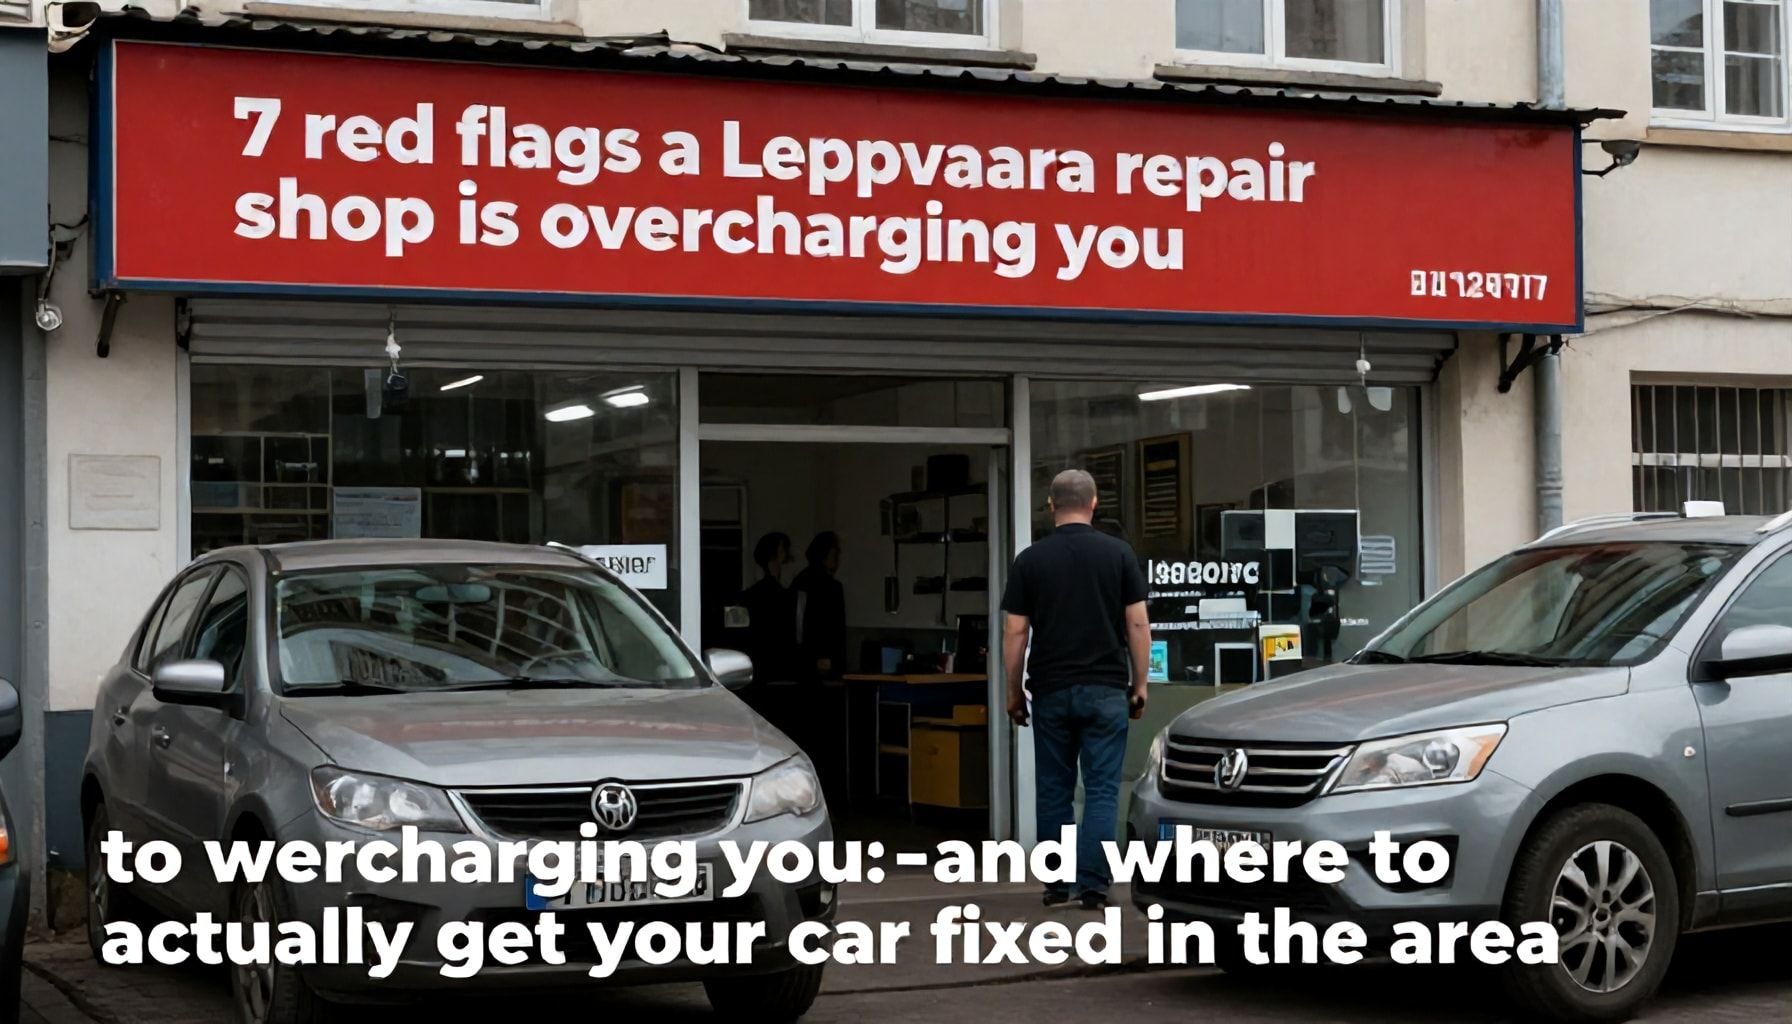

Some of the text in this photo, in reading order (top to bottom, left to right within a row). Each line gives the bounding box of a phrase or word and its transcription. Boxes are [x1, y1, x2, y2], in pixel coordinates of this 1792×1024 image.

[234, 97, 1315, 211] 7 red flags a Leppvaara repair
[234, 178, 1184, 280] shop is overcharging you
